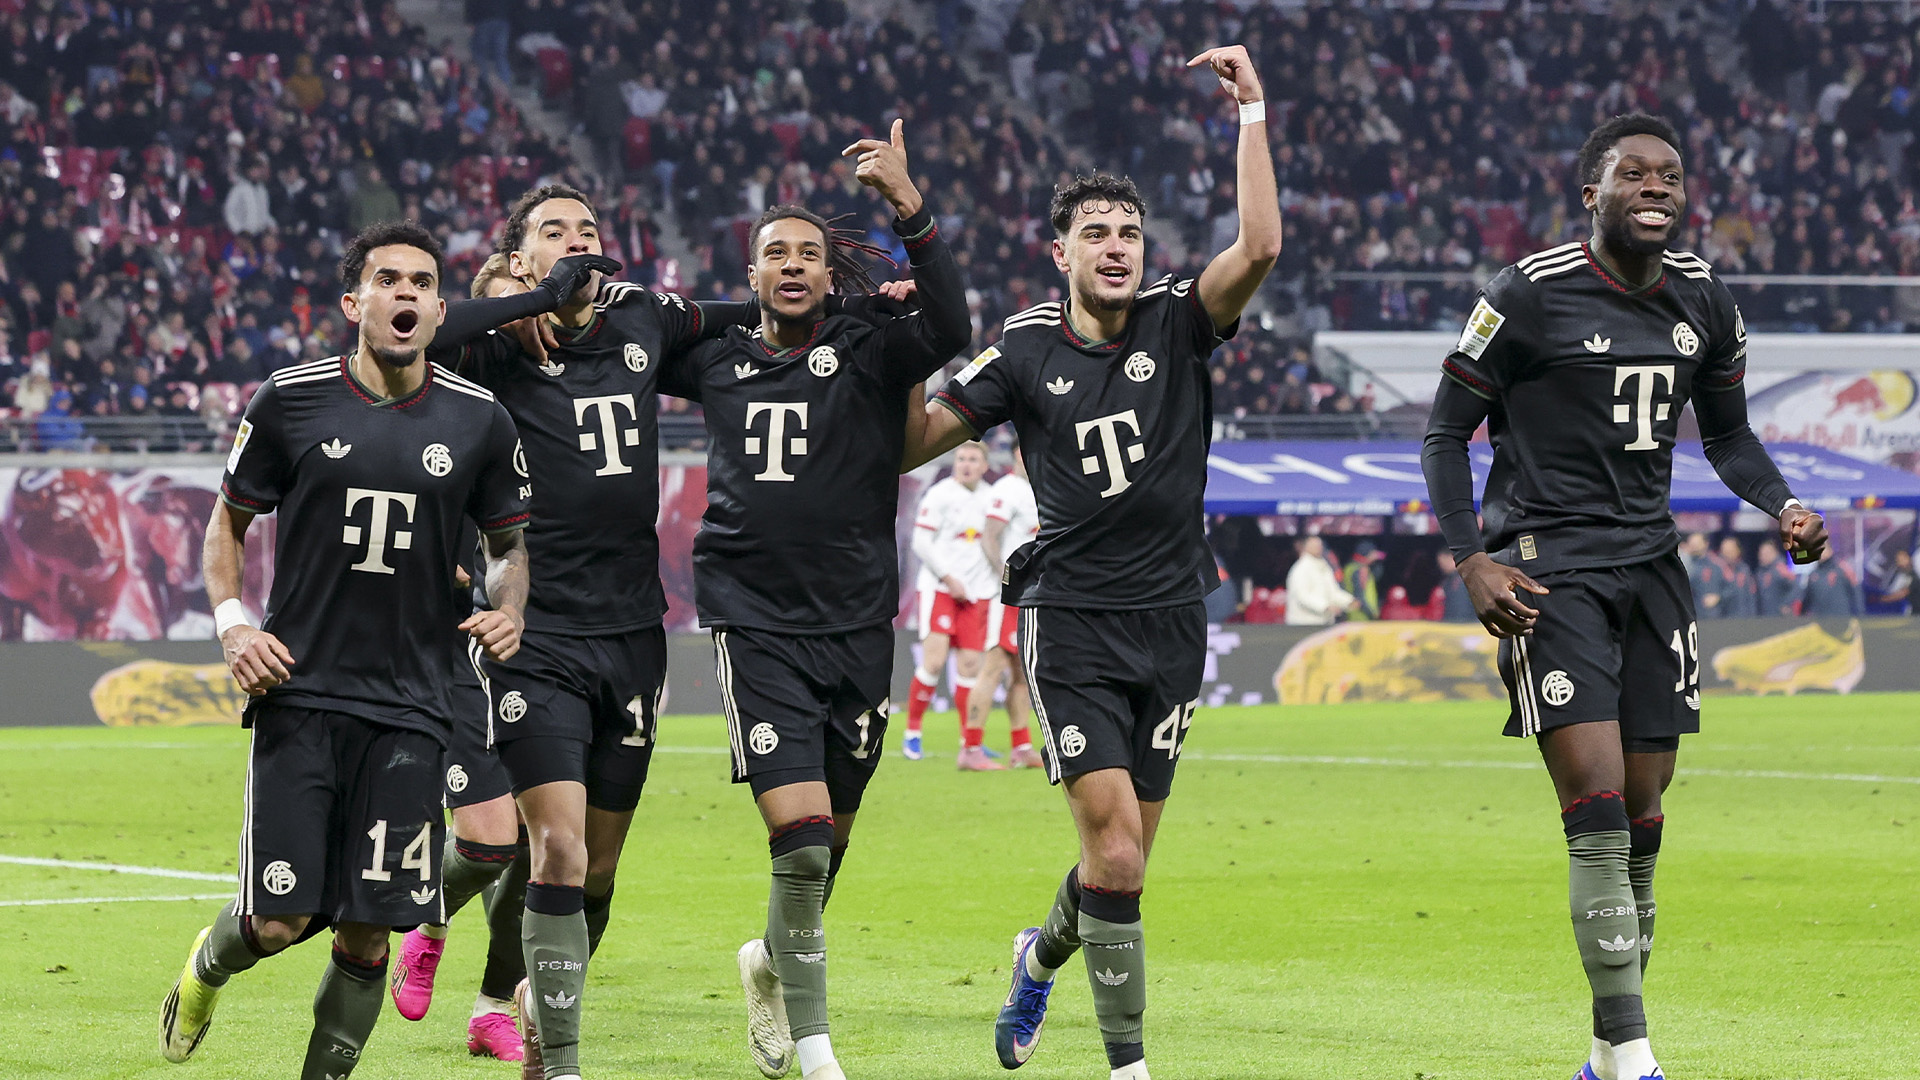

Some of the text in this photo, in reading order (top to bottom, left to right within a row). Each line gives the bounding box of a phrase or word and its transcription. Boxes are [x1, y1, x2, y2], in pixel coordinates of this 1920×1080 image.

[573, 393, 640, 477] T
[744, 401, 808, 482] T
[1613, 365, 1675, 450] T
[1075, 409, 1146, 499] T
[342, 488, 417, 575] T
[1670, 620, 1699, 693] 19
[361, 819, 432, 882] 14
[1586, 906, 1636, 919] FCBM
[537, 960, 583, 972] FCBM
